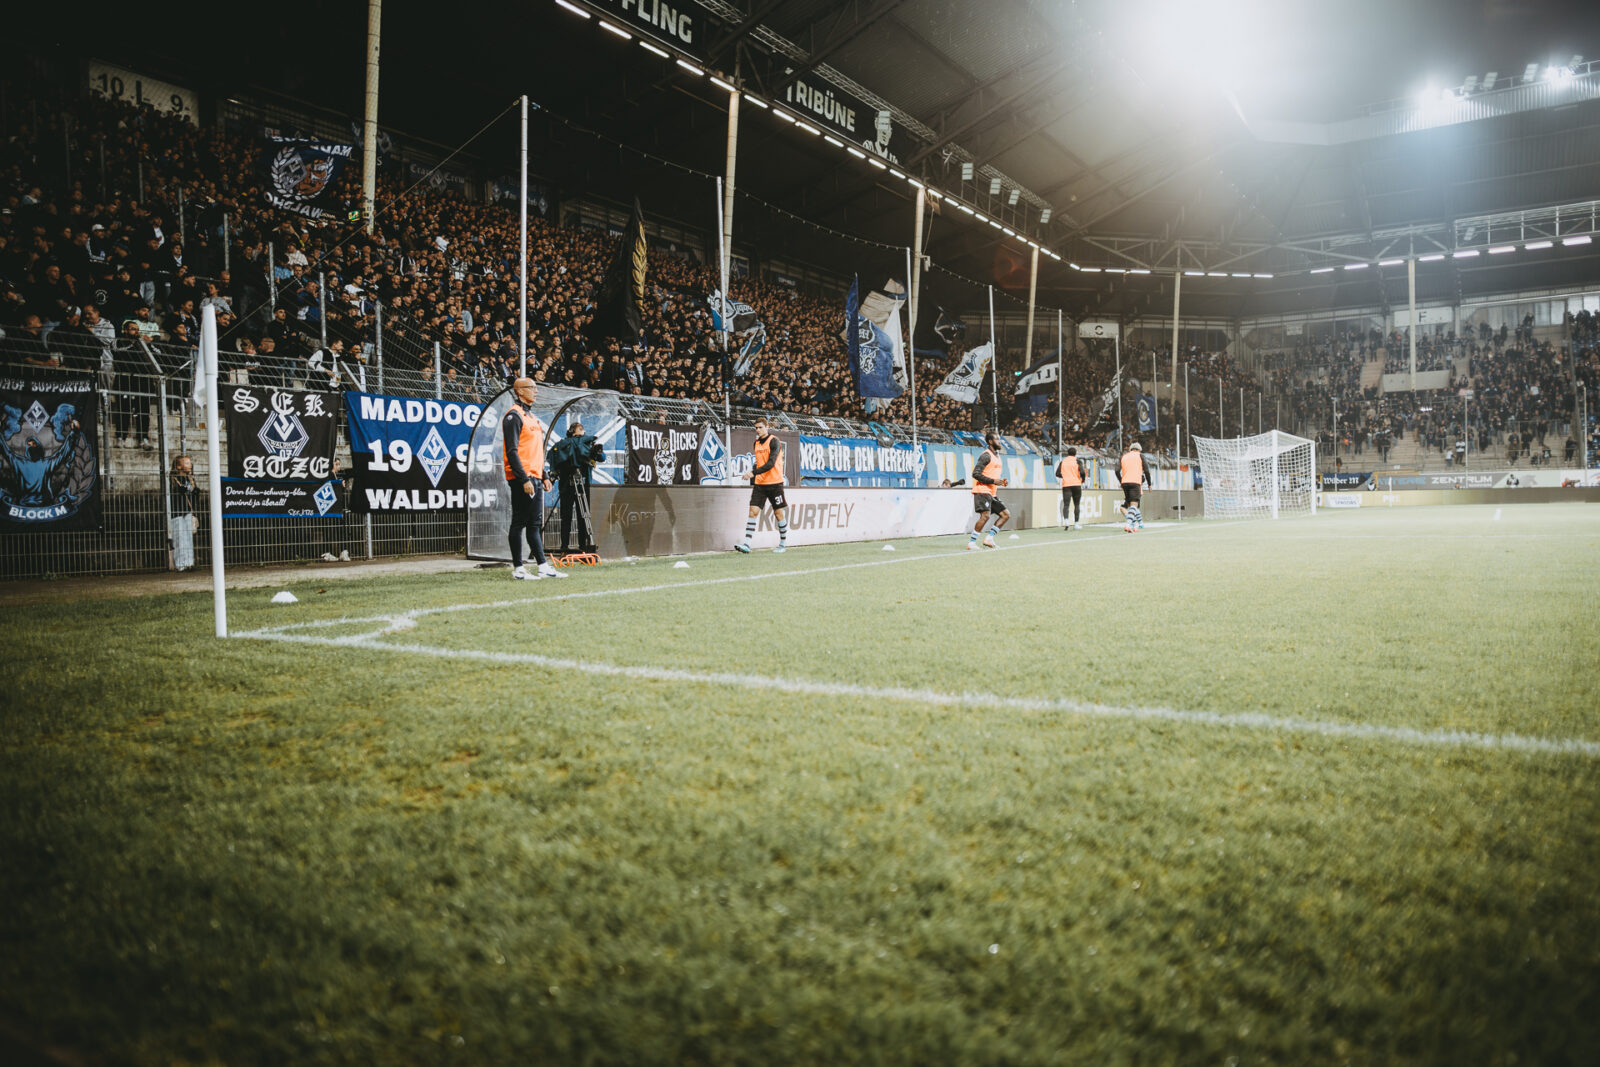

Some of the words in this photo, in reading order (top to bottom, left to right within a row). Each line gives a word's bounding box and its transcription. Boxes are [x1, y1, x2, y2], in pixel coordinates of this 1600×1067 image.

[360, 396, 498, 428] MADDOGS
[367, 439, 413, 473] 19
[455, 443, 494, 473] 95
[828, 440, 851, 472] FÜR
[854, 446, 875, 472] DEN
[877, 447, 914, 473] VEREIN
[637, 464, 652, 483] 20
[1431, 475, 1493, 486] ZENTRUM
[365, 488, 498, 510] WALDHOF
[774, 495, 783, 505] 31
[9, 506, 54, 519] BLOCK
[55, 505, 68, 515] M
